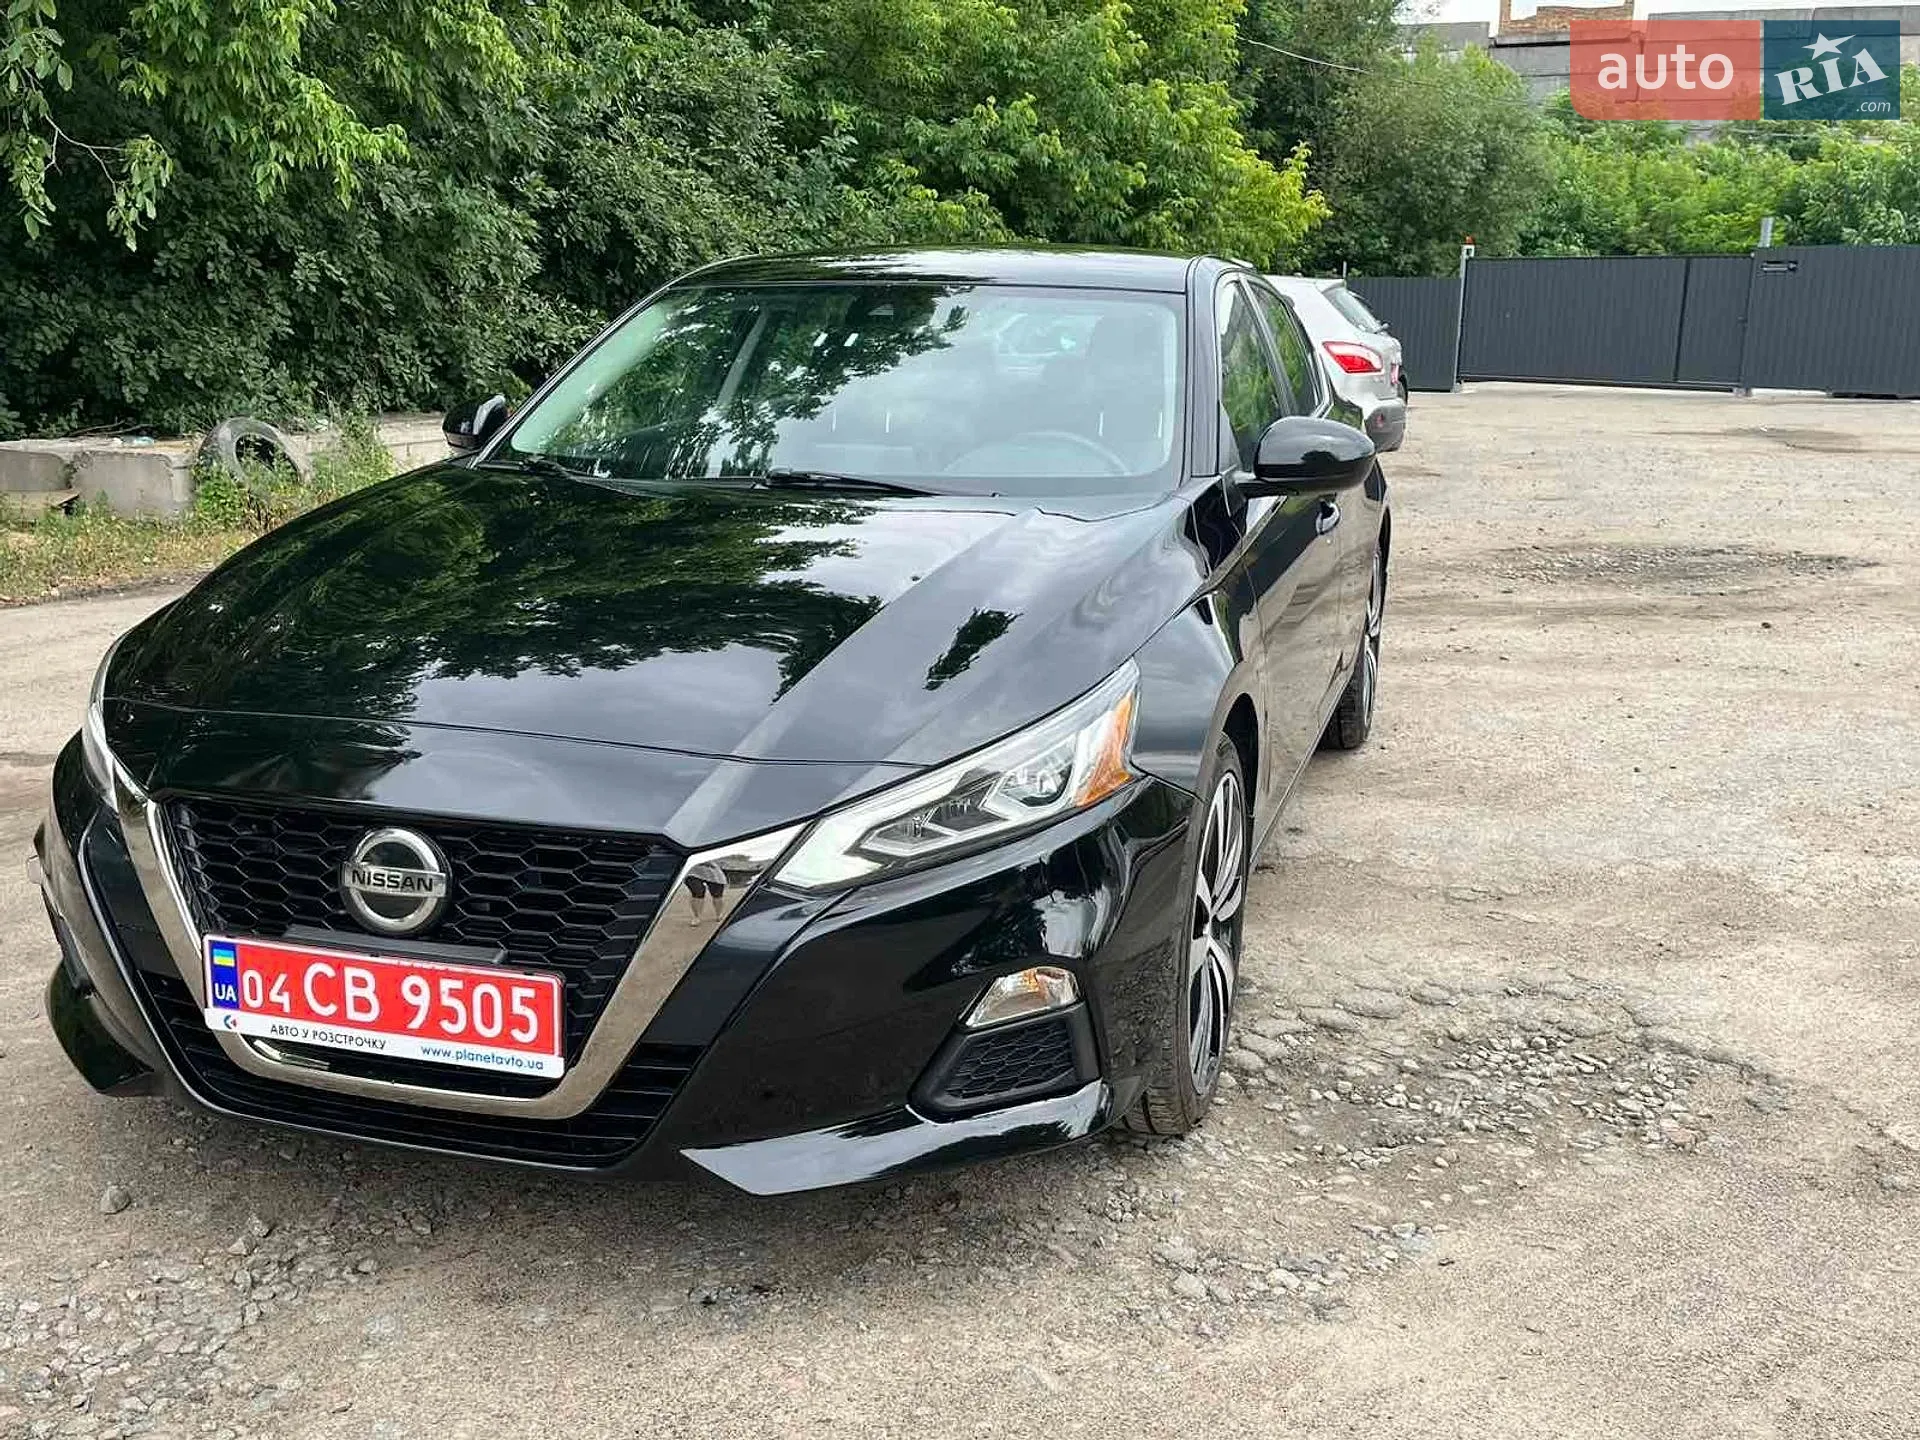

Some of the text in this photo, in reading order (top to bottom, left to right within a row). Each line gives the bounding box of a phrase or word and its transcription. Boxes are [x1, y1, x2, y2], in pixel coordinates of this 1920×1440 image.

[351, 869, 434, 892] NISSAN
[214, 985, 237, 1002] UA
[242, 962, 539, 1044] 04 CB 9505
[270, 1023, 387, 1051] АВТО У РОЗСТРОЧКУ
[420, 1044, 544, 1071] www.planetavto.ua
